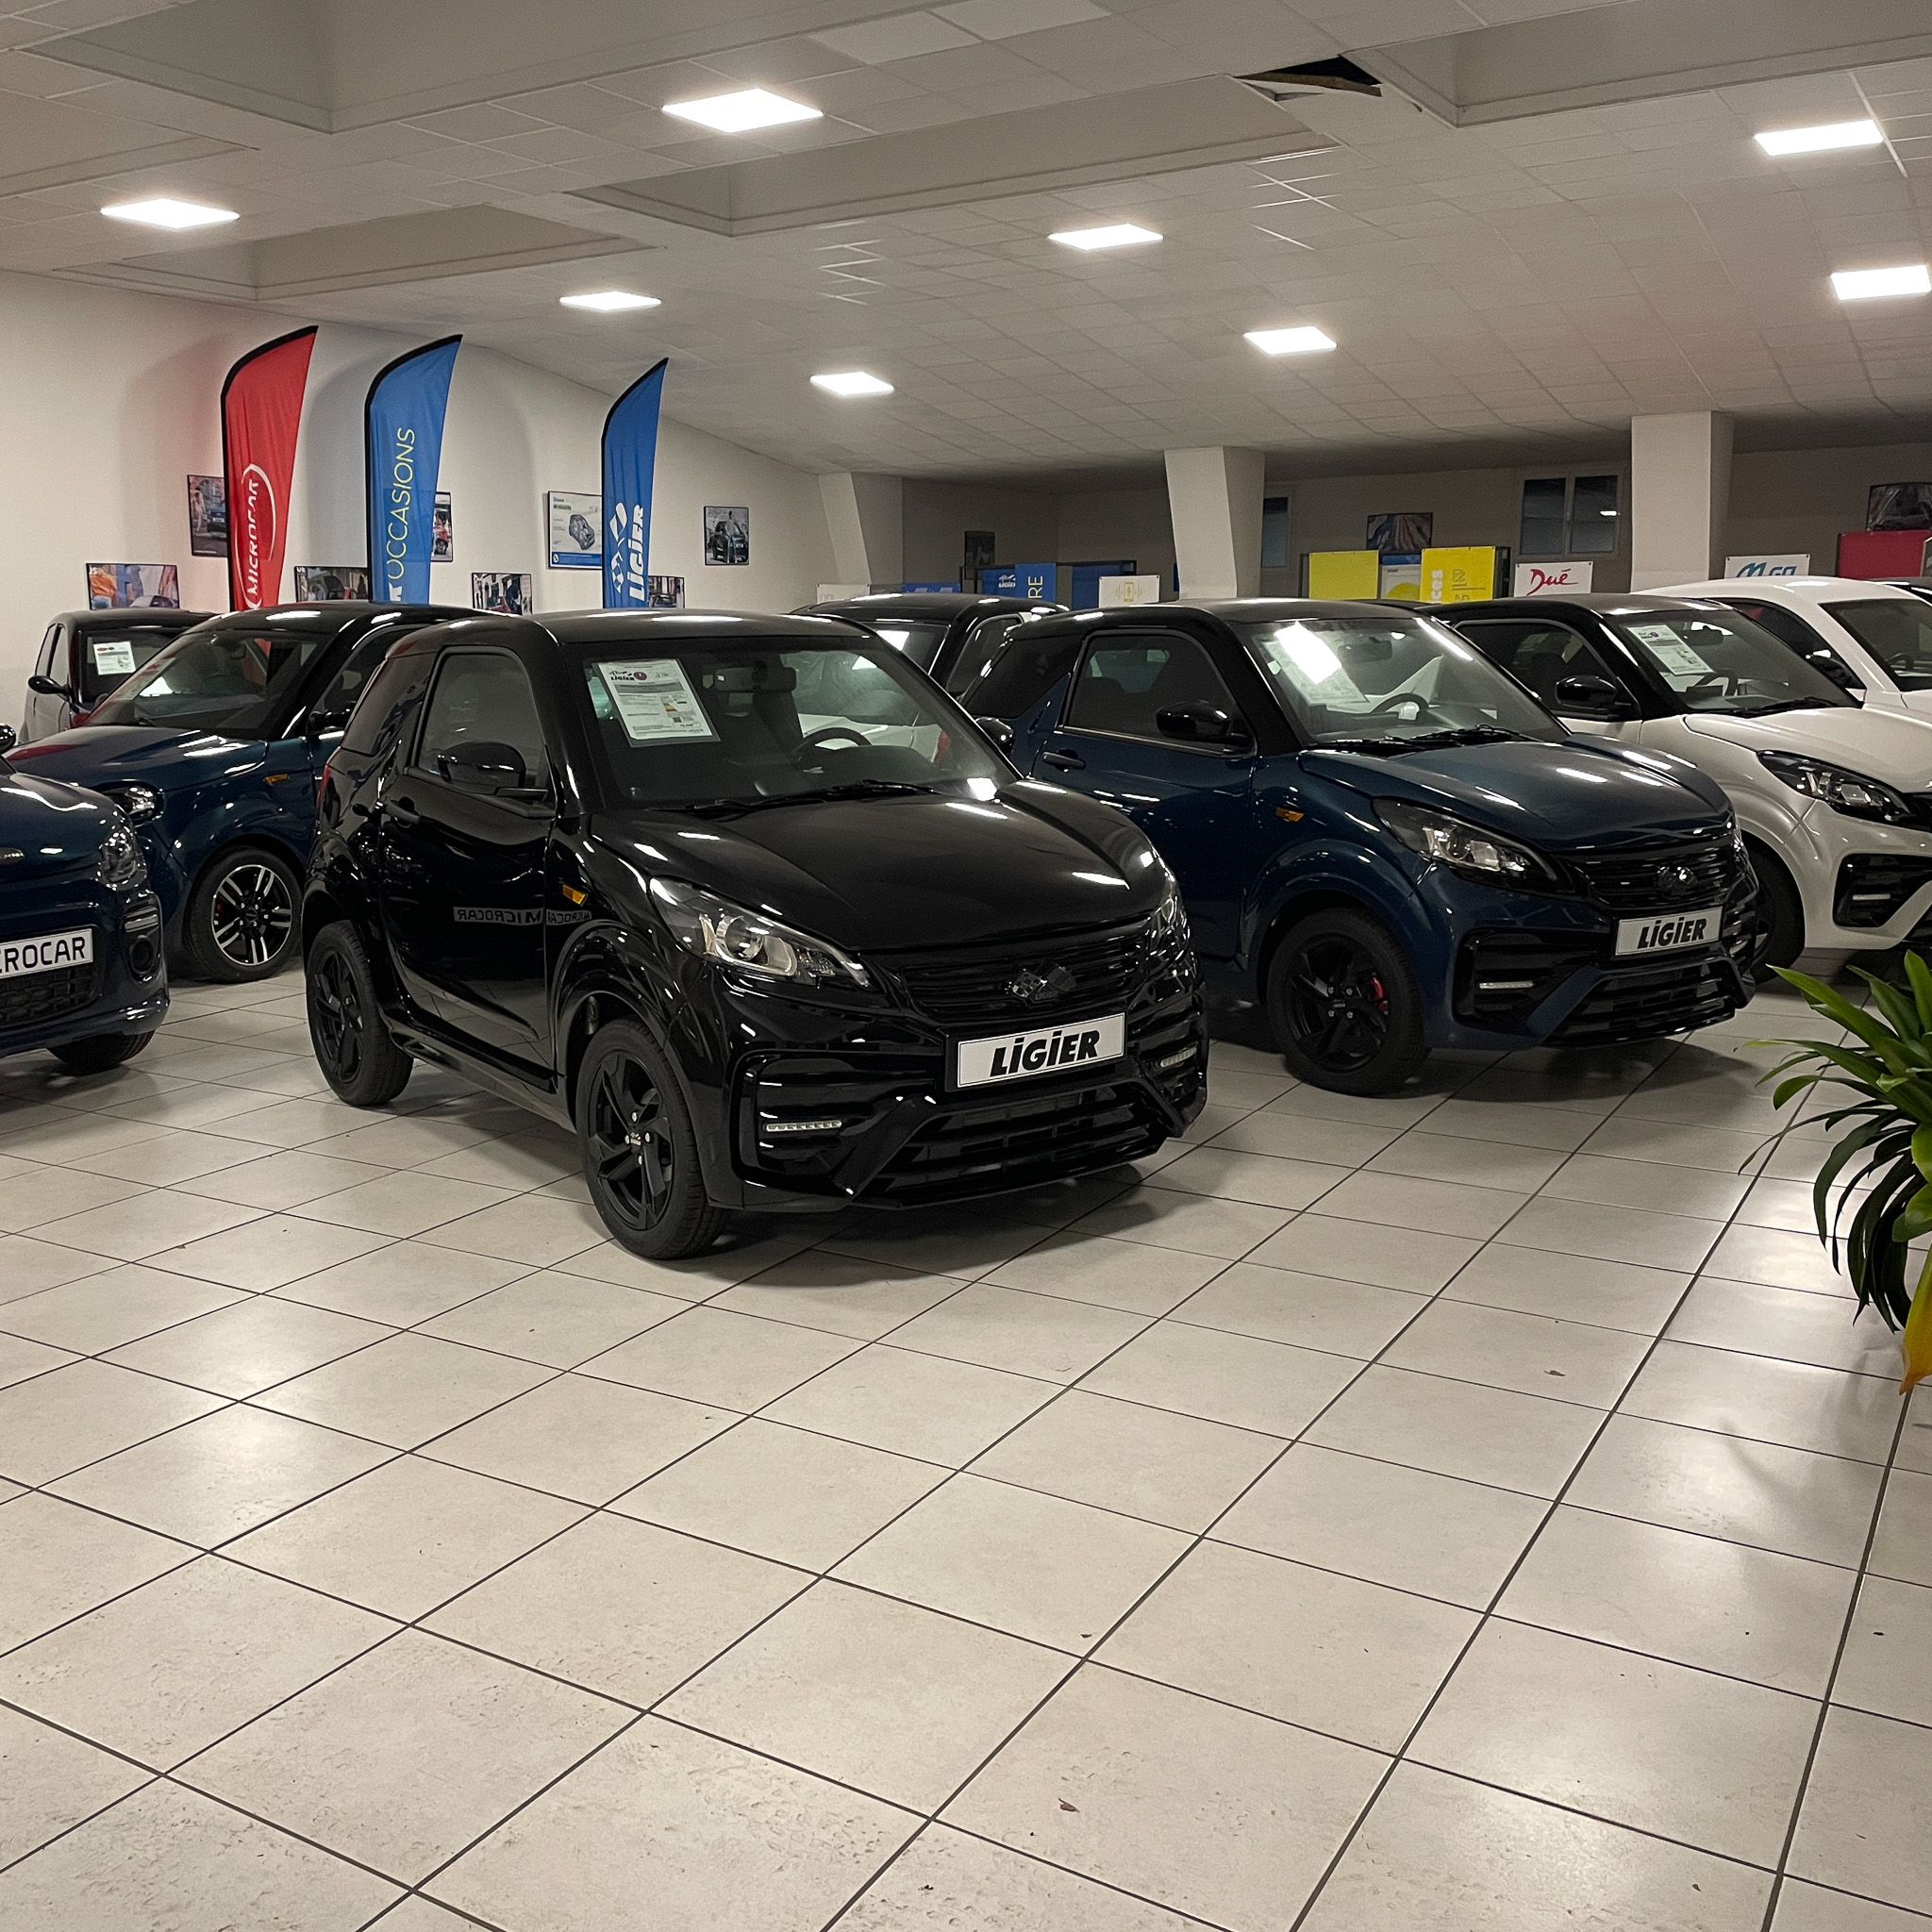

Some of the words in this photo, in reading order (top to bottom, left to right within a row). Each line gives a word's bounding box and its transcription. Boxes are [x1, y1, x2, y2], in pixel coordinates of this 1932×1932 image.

[386, 426, 415, 580] OCCASIONS
[627, 504, 644, 601] LIGIER
[0, 937, 85, 974] ROCAR
[1638, 916, 1707, 950] LIGIER
[990, 1029, 1100, 1077] LIGIER
